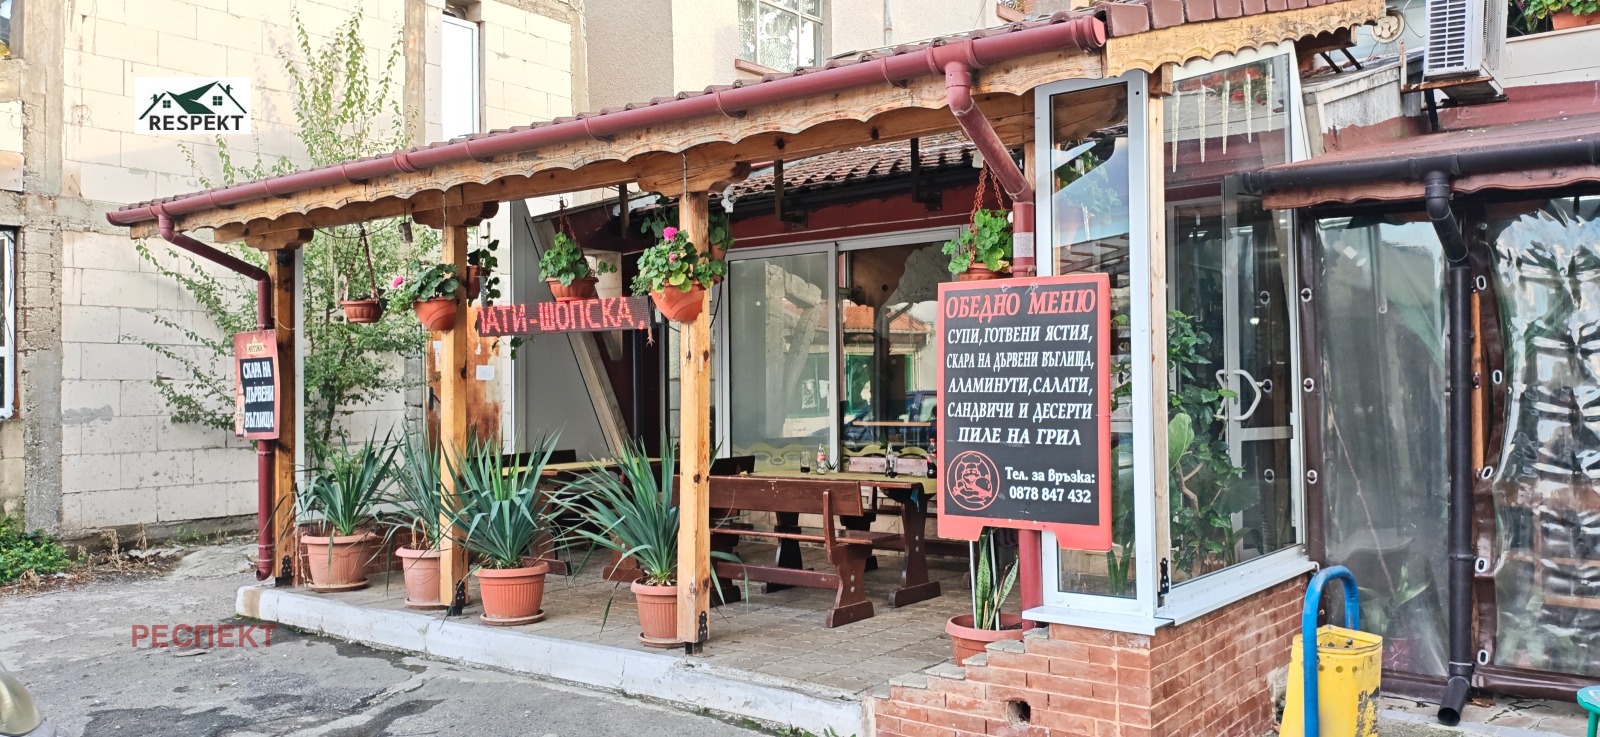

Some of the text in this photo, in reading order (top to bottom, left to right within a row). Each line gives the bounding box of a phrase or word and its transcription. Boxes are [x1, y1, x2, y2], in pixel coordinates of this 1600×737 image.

[945, 289, 1096, 323] ОБЕДНО МЕНЮ
[1044, 324, 1093, 343] ЯСТИЯ,
[243, 361, 272, 379] СКАРА НА
[946, 351, 1094, 372] СКАРА НА ДЪРВЕНИ ВЪГЛИЩА,
[245, 385, 274, 404] ДЪРВЕНИ
[244, 411, 274, 429] ВЪГЛИЩА
[947, 402, 1093, 423] САНДВИЧИ И ДЕСЕРТИ
[957, 427, 1081, 445] ПИЛЕ НА ГРИЛ
[1005, 466, 1029, 481] Тел.
[1031, 471, 1045, 482] за
[1009, 485, 1092, 503] 0878 847 432
